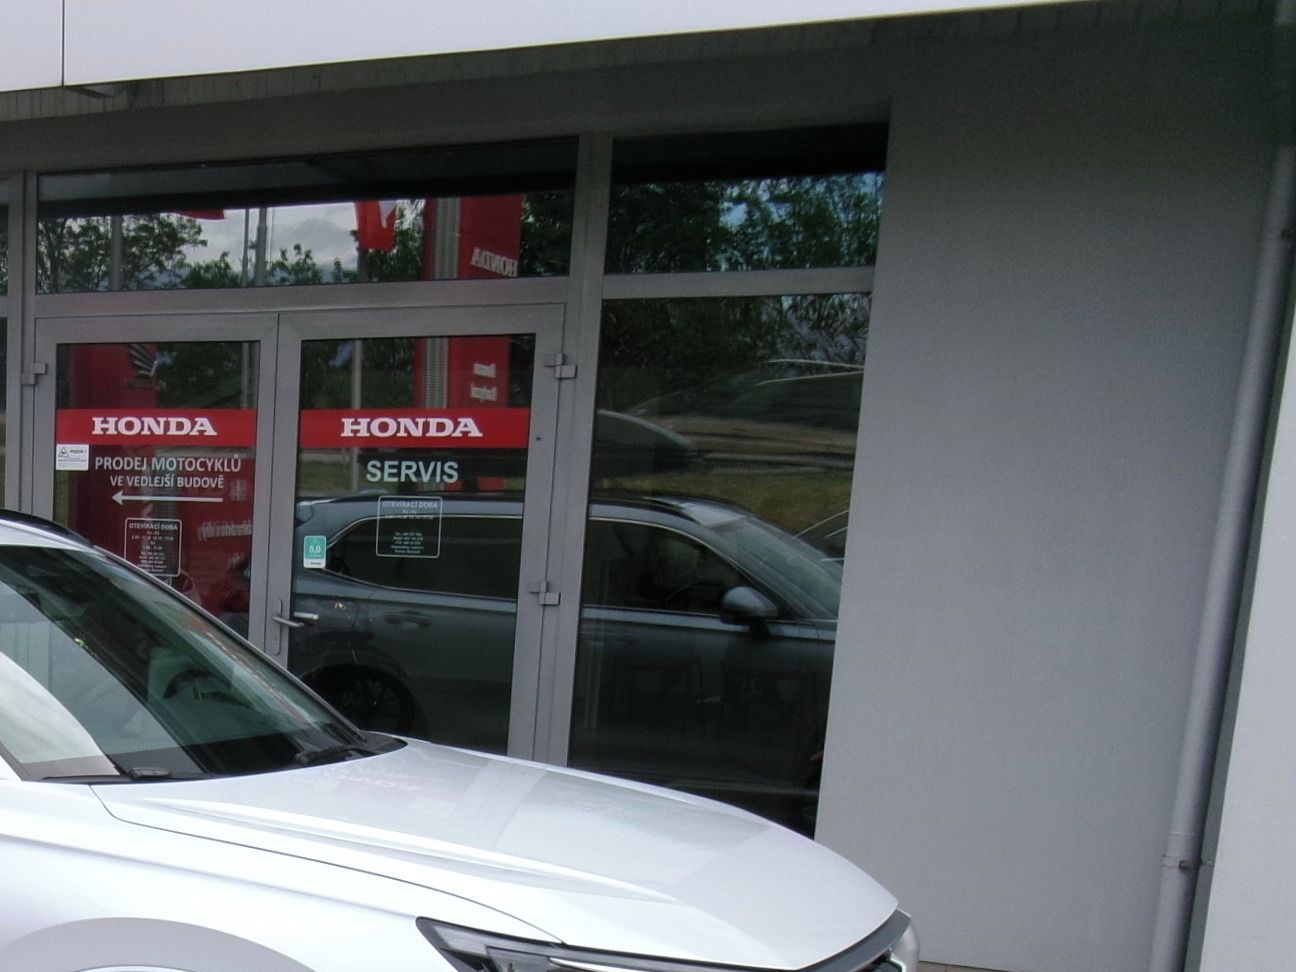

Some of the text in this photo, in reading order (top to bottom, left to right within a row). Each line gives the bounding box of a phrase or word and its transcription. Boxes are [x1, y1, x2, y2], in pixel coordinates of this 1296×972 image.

[91, 416, 217, 436] HONDA
[340, 417, 483, 438] HONDA
[94, 456, 147, 472] PRODEJ
[151, 454, 242, 473] MOTOCYKLŮ
[365, 460, 459, 484] SERVIS
[110, 473, 224, 489] VE VEDLEJŠÍ BUDOVĚ
